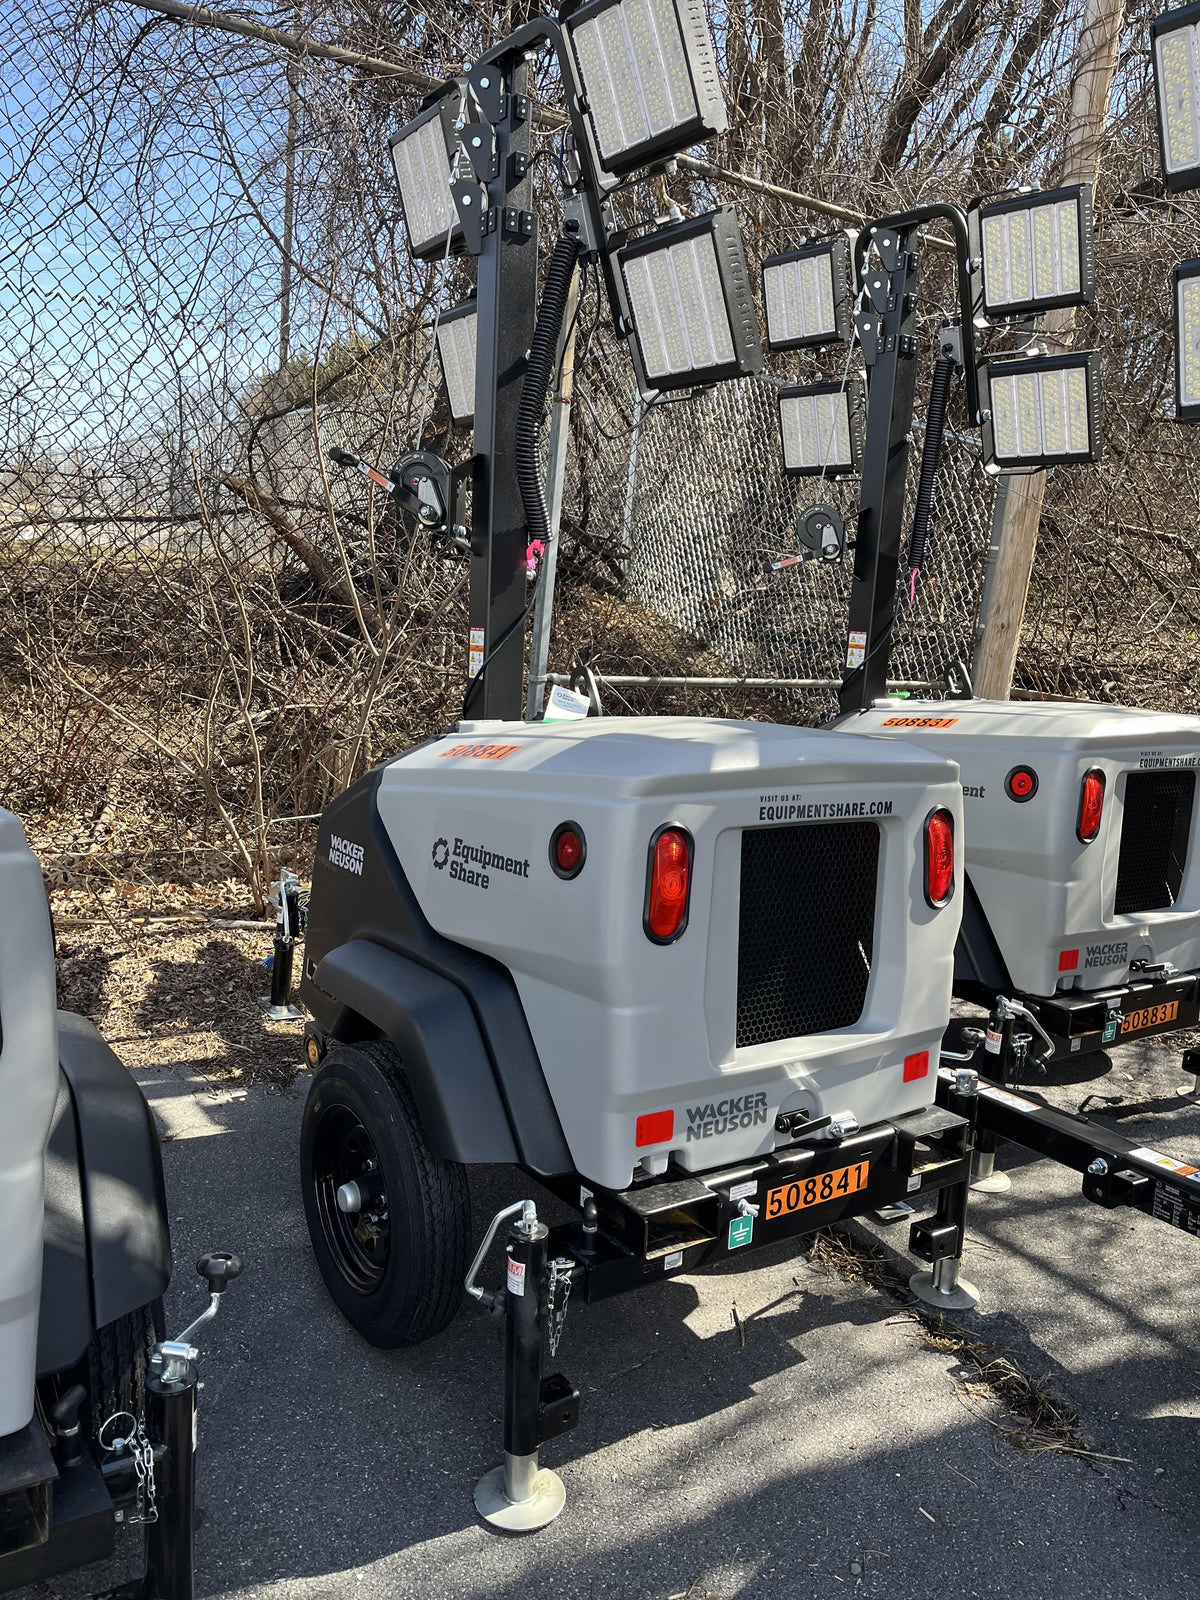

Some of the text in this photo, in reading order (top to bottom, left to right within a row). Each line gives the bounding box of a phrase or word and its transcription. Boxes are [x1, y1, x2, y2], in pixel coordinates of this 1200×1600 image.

[883, 717, 955, 728] 508831
[442, 744, 518, 759] 508841
[1139, 757, 1200, 768] EQUIPMENTSHARE.C
[962, 786, 986, 798] ent
[759, 801, 893, 821] EQUIPMENTSHARE.COM
[330, 833, 365, 862] WACKER
[452, 837, 530, 878] Equipment
[328, 848, 363, 876] NEUSON
[449, 859, 490, 890] Share
[1084, 953, 1127, 969] NEUSON
[1086, 942, 1128, 957] WACKER
[1122, 1002, 1176, 1032] 508831
[686, 1091, 768, 1124] WACKER
[686, 1108, 767, 1142] NEUSON
[769, 1164, 864, 1217] 508841
